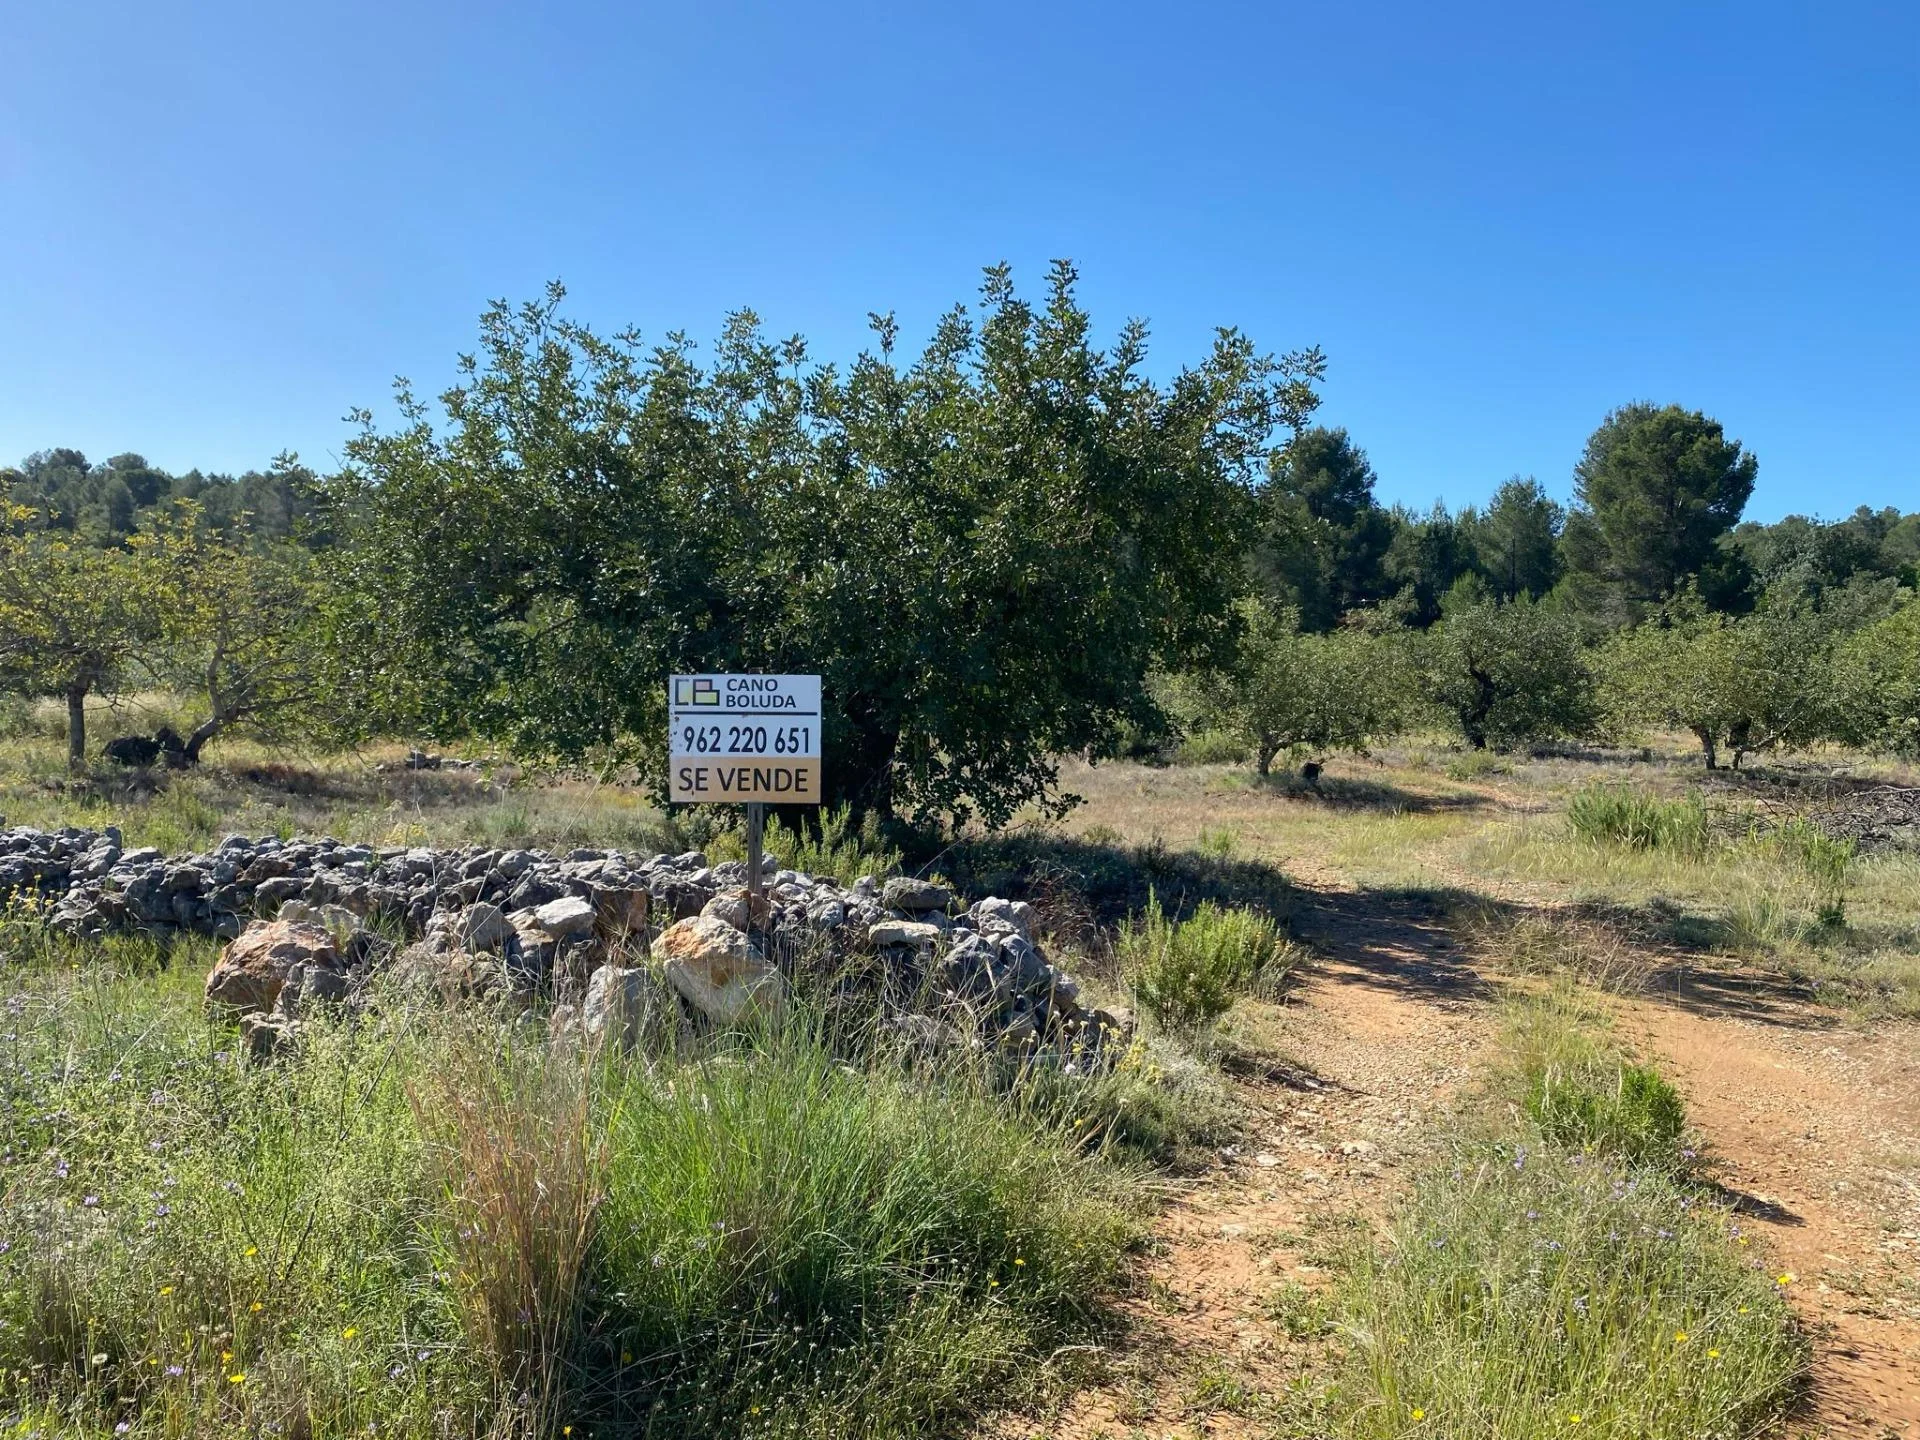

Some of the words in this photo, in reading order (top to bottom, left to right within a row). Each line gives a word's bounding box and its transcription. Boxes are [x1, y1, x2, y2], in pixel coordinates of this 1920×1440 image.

[726, 678, 778, 692] CANO
[726, 694, 796, 708] BOLUDA
[683, 726, 721, 753] 962
[728, 726, 767, 753] 220
[774, 727, 809, 753] 651
[678, 767, 708, 792] SE
[716, 767, 808, 792] VENDE
